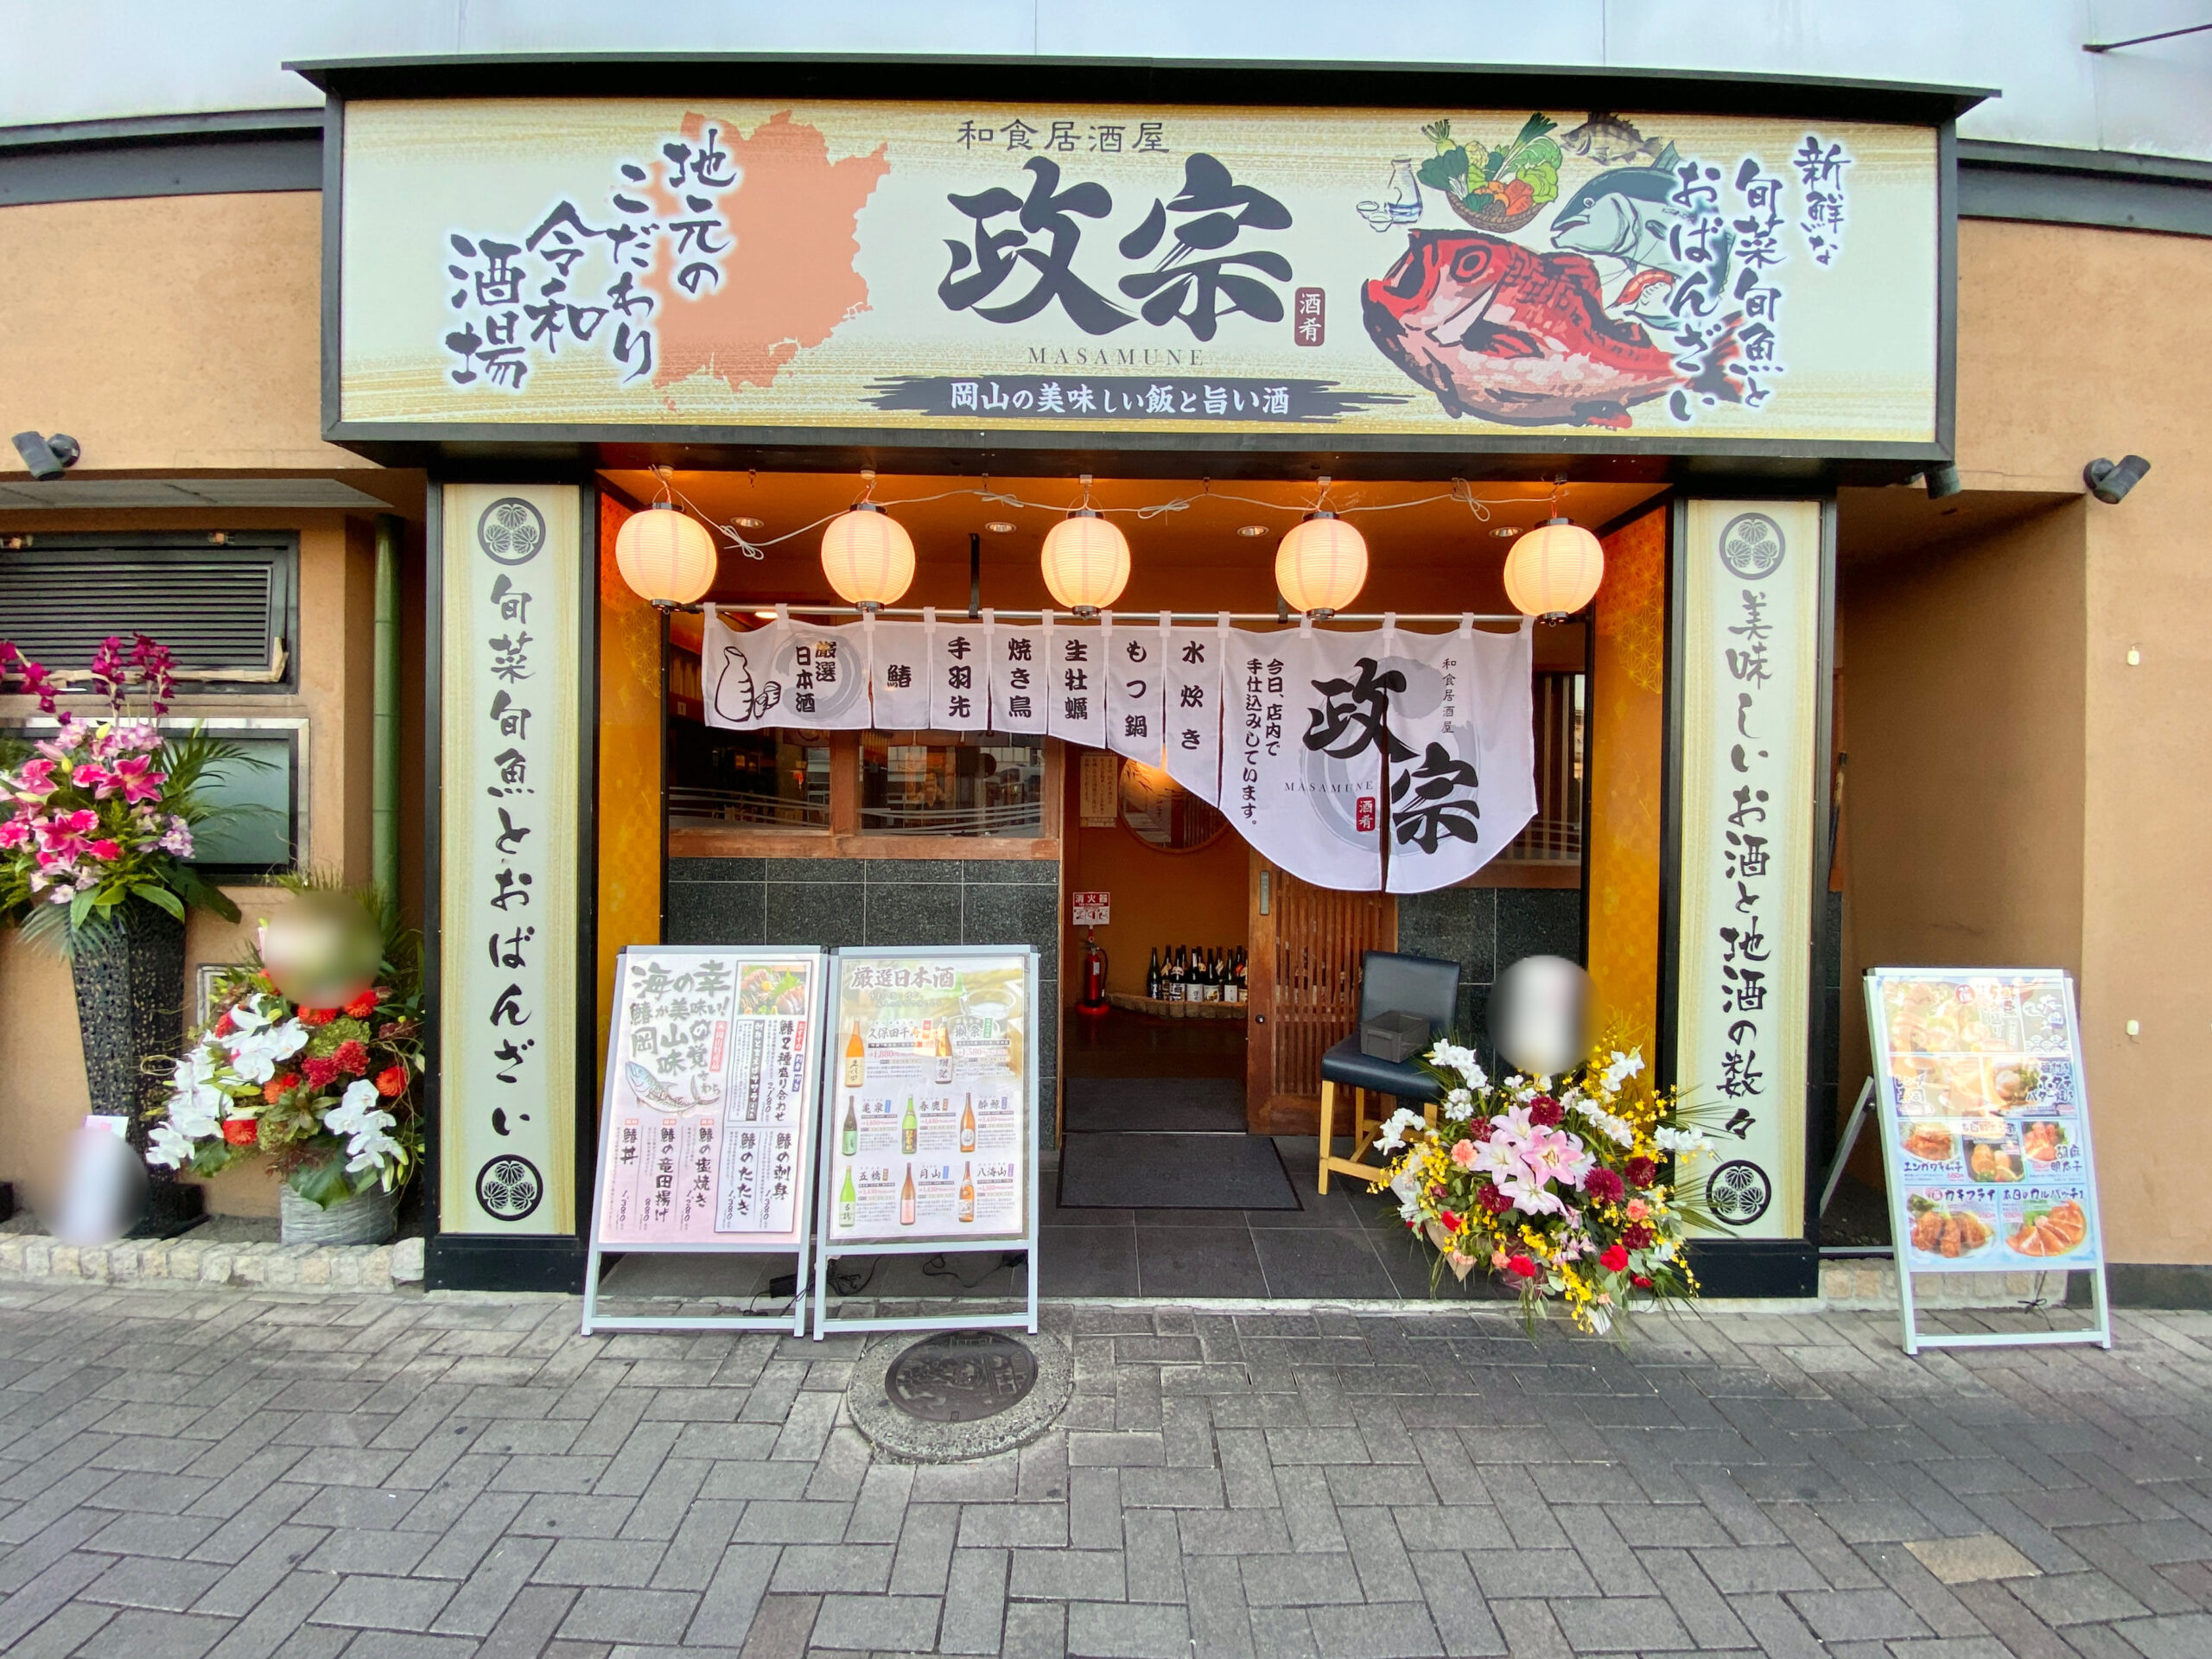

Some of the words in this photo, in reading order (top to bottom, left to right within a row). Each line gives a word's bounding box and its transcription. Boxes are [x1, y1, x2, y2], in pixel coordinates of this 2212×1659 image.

[957, 118, 1171, 153] 和食居酒屋
[662, 128, 737, 294] 地元の
[1792, 136, 1853, 267] 新鮮な
[522, 200, 607, 353] 令和
[605, 163, 660, 384] こだわり
[937, 152, 1294, 342] 政宗
[1730, 158, 1787, 409] 旬菜旬魚と
[444, 233, 528, 389] 酒場
[1297, 290, 1324, 344] 酒肴
[1668, 160, 1723, 423] おばんざい
[1027, 347, 1205, 366] MASAMUNE
[950, 381, 1290, 416] 岡山の美味しい飯と旨い酒
[795, 645, 817, 714] 日本酒
[816, 640, 837, 683] 厳選
[887, 664, 912, 690] 鰆
[947, 636, 972, 719] 手羽先
[1007, 638, 1033, 718] 焼き鳥
[1064, 639, 1089, 721] 生牡蠣
[1123, 639, 1148, 739] もつ鍋
[1179, 640, 1205, 751] 水炊き
[1441, 658, 1457, 734] 和食居酒屋
[1241, 658, 1263, 826] 手仕込みしています。
[1265, 658, 1285, 757] 今日、店内で
[1284, 780, 1374, 793] MASAMUNE
[1301, 657, 1480, 855] 政宗
[486, 572, 537, 1137] 旬菜旬魚とおばんざい
[1357, 798, 1374, 830] 酒肴
[1075, 893, 1109, 904] 消火器
[1715, 589, 1774, 1141] 美味しいお酒と地酒の数々
[631, 959, 733, 1001] 海の幸
[851, 966, 955, 989] 厳選日本酒
[631, 1019, 711, 1057] 岡山の
[693, 1128, 714, 1208] 鰆の塩焼き
[737, 1132, 756, 1216] 鰆のたたき
[1945, 1188, 1996, 1201] カキフライ
